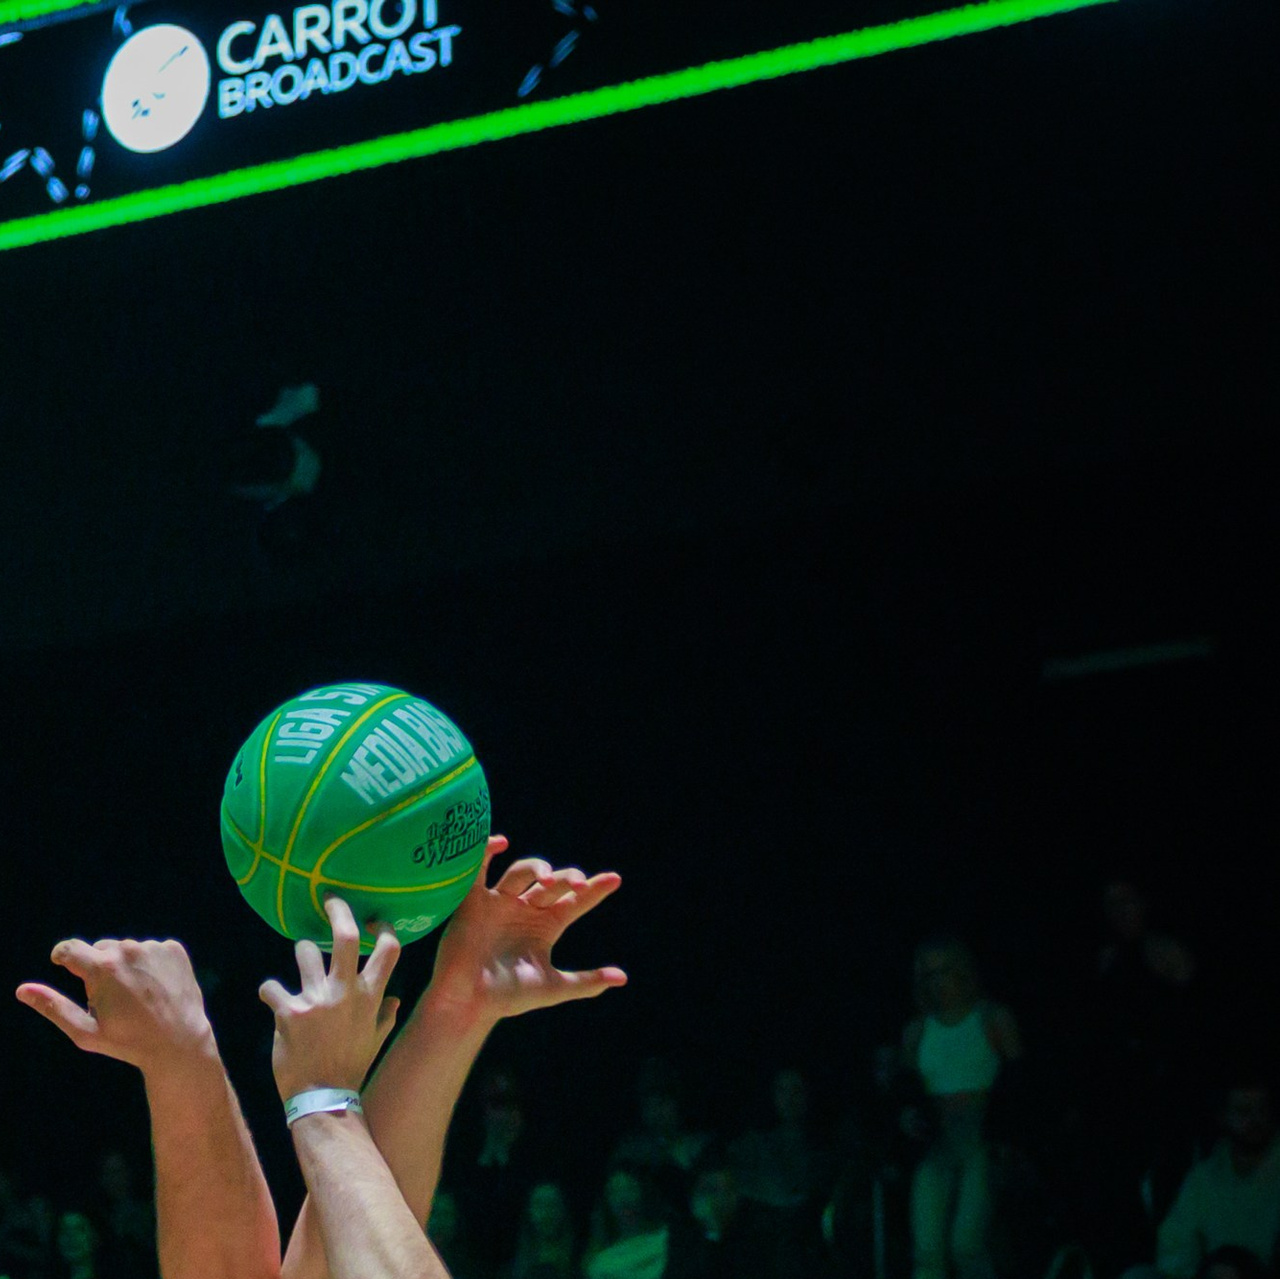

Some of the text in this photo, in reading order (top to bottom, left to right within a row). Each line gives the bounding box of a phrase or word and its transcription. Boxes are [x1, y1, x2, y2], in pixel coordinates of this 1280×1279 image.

[218, 24, 462, 119] BROADCAST
[275, 708, 351, 764] LIGA
[340, 708, 439, 805] MEDIA
